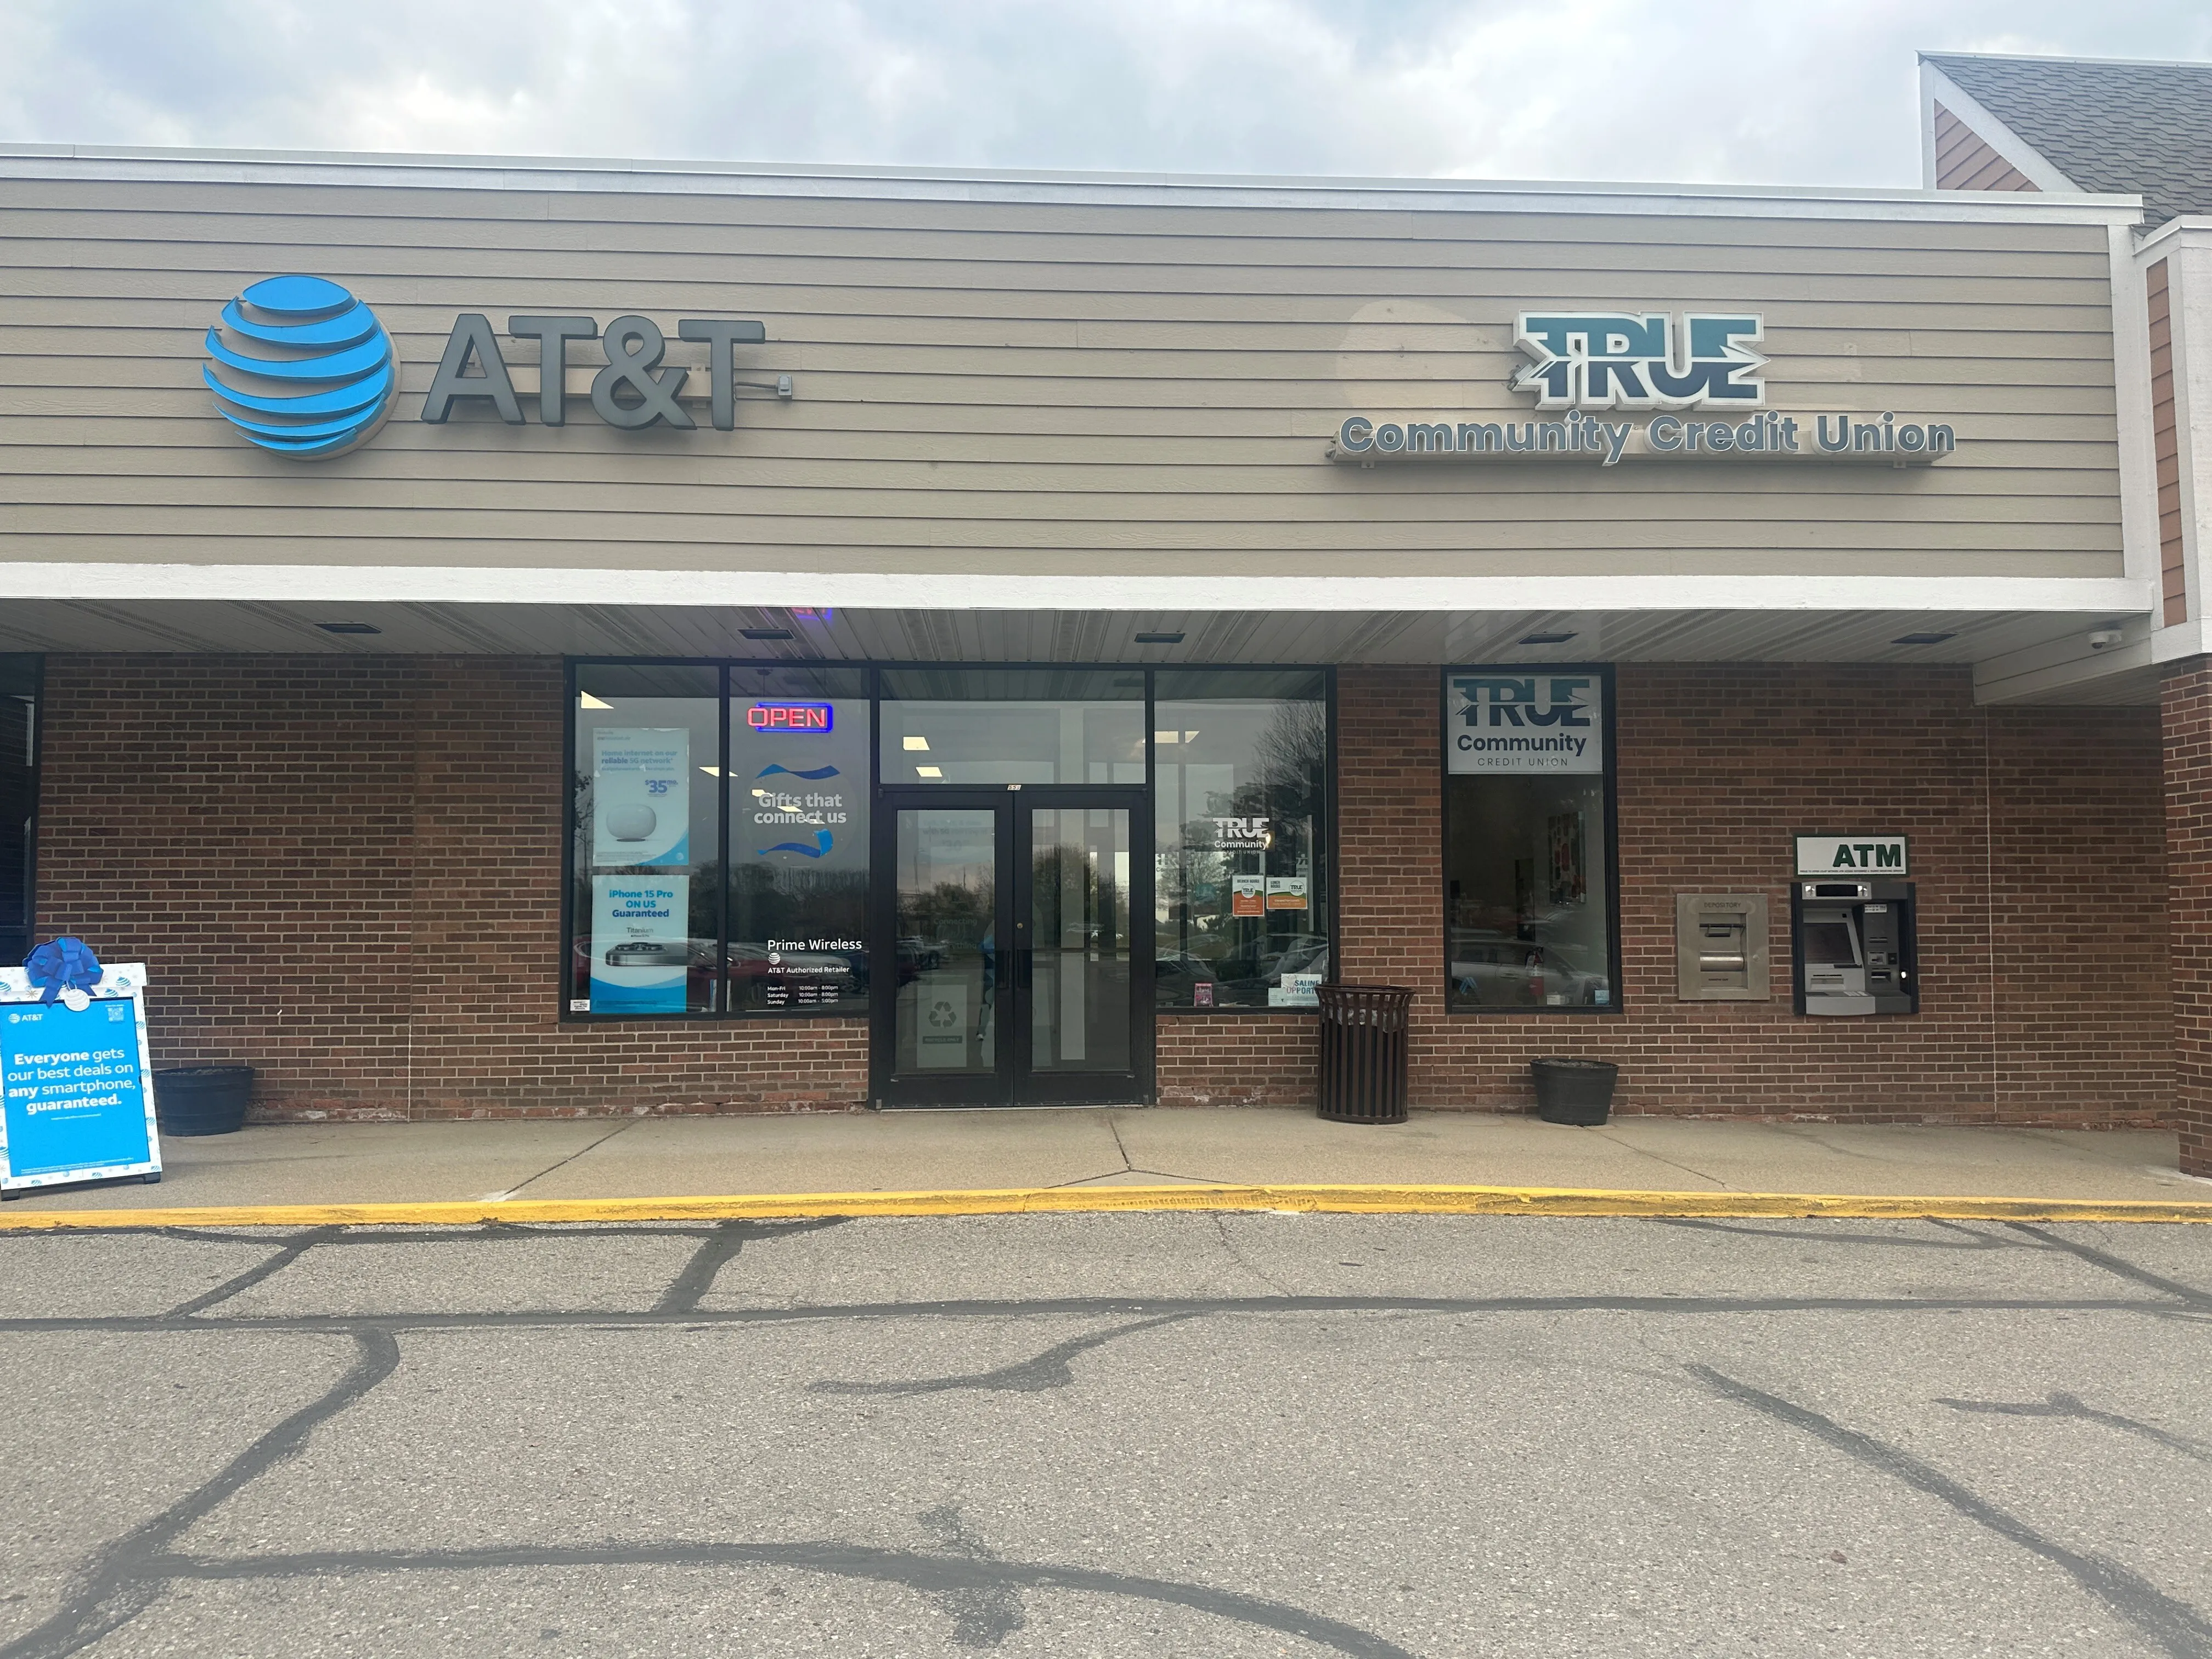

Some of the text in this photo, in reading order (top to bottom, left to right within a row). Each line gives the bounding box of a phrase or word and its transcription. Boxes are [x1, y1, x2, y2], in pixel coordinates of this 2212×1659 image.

[1517, 312, 1767, 403] TRUE
[421, 313, 765, 431] AT&T
[1339, 410, 1956, 466] Community Credit Union
[1453, 678, 1590, 727] TRUE
[747, 707, 827, 728] OPEN
[1457, 732, 1587, 757] Community
[1477, 758, 1568, 766] CREDIT UNION
[758, 792, 843, 808] Gifts that
[754, 810, 847, 824] connect us
[1213, 817, 1269, 838] TRUE
[1214, 840, 1267, 850] Community
[1832, 844, 1901, 868] ATM
[609, 889, 673, 898] iPhone 15 Pro
[612, 909, 669, 918] Guaranteed
[933, 918, 978, 927] Connecting
[768, 938, 862, 951] Prime Wireless
[14, 1049, 125, 1066] Everyone gets
[8, 1062, 134, 1081] our best deals on
[8, 1079, 136, 1099] any smartphone,
[26, 1094, 122, 1115] guaranteed.
